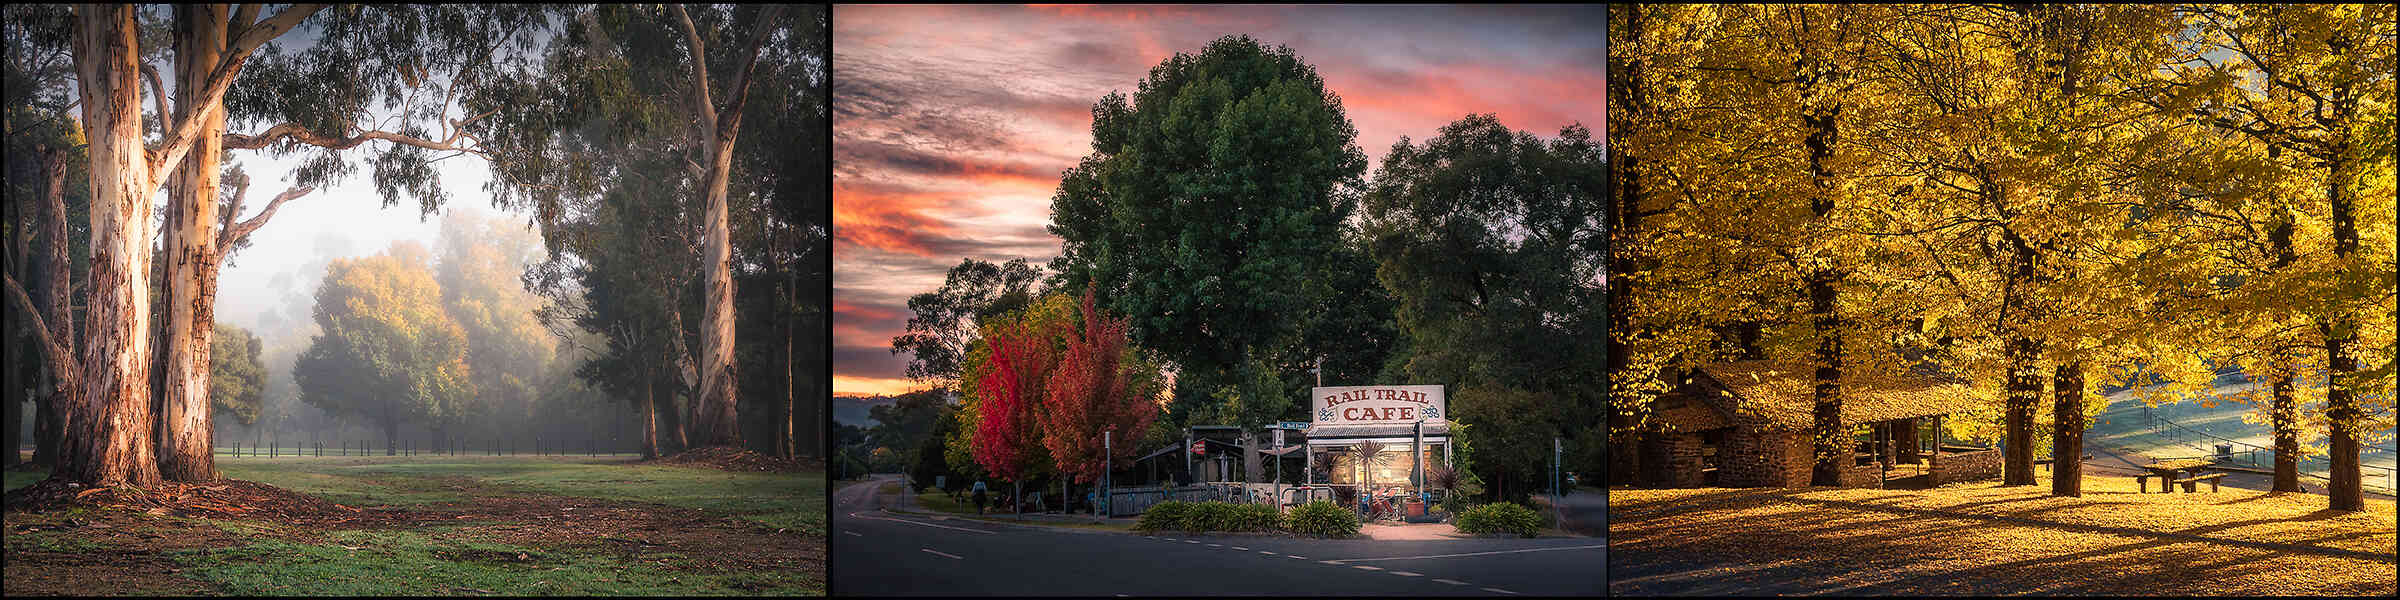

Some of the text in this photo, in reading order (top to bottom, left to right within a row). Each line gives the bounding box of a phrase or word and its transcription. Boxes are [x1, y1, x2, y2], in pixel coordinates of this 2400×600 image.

[1325, 389, 1429, 408] RAIL TRAIL
[1343, 407, 1414, 421] CAFE
